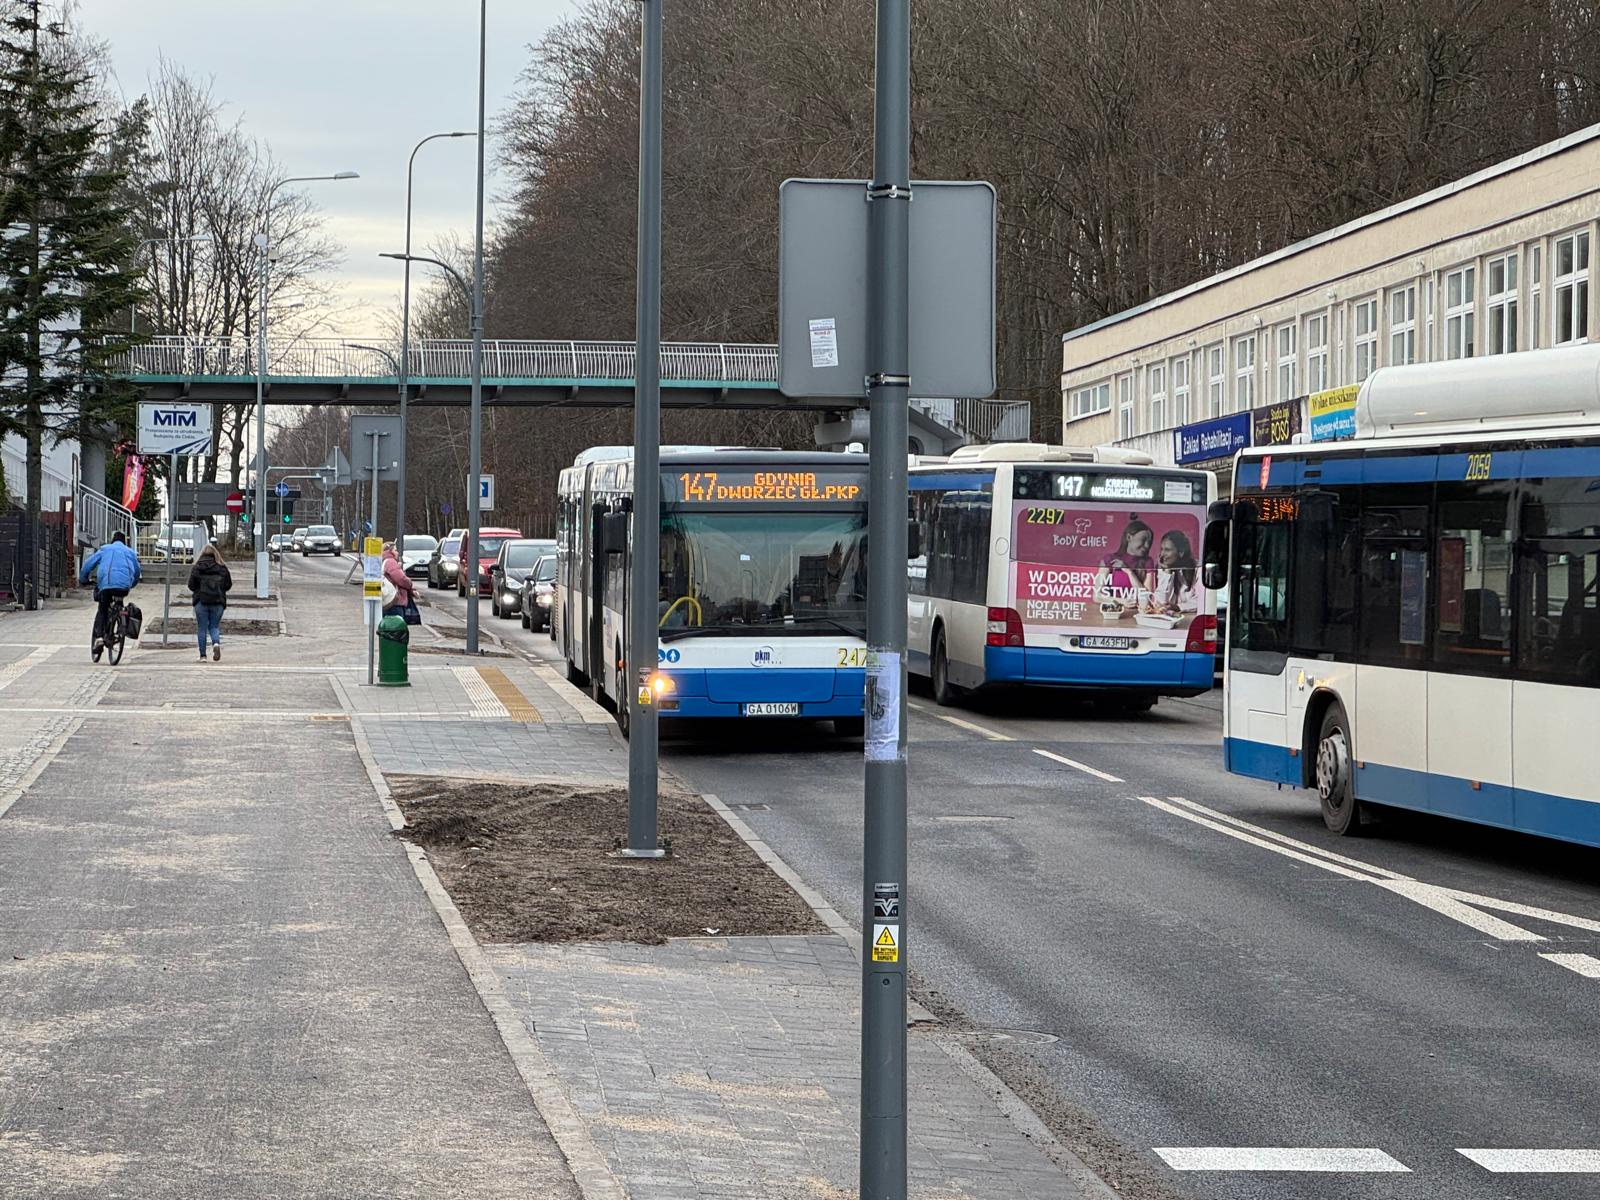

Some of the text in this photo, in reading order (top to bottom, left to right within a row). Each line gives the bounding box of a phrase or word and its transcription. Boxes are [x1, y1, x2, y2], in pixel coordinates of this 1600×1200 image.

[153, 410, 196, 426] MTM
[1466, 454, 1491, 480] 2059
[679, 473, 717, 500] 147
[754, 473, 816, 486] GDYNIA
[1057, 475, 1084, 497] 147
[717, 486, 796, 499] DWORZEC
[1027, 508, 1064, 525] 2297
[1052, 534, 1108, 548] BODY CHIEF
[1028, 570, 1113, 586] W DOBRYM
[1028, 583, 1147, 600] TOWARZYSTWIE
[1026, 600, 1087, 612] NOT A DIET.
[1026, 611, 1082, 620] LIFESTYLE.
[1085, 637, 1127, 648] GA 463FH
[754, 649, 770, 662] pkm
[837, 648, 867, 667] 247
[748, 703, 797, 714] GA 0106W
